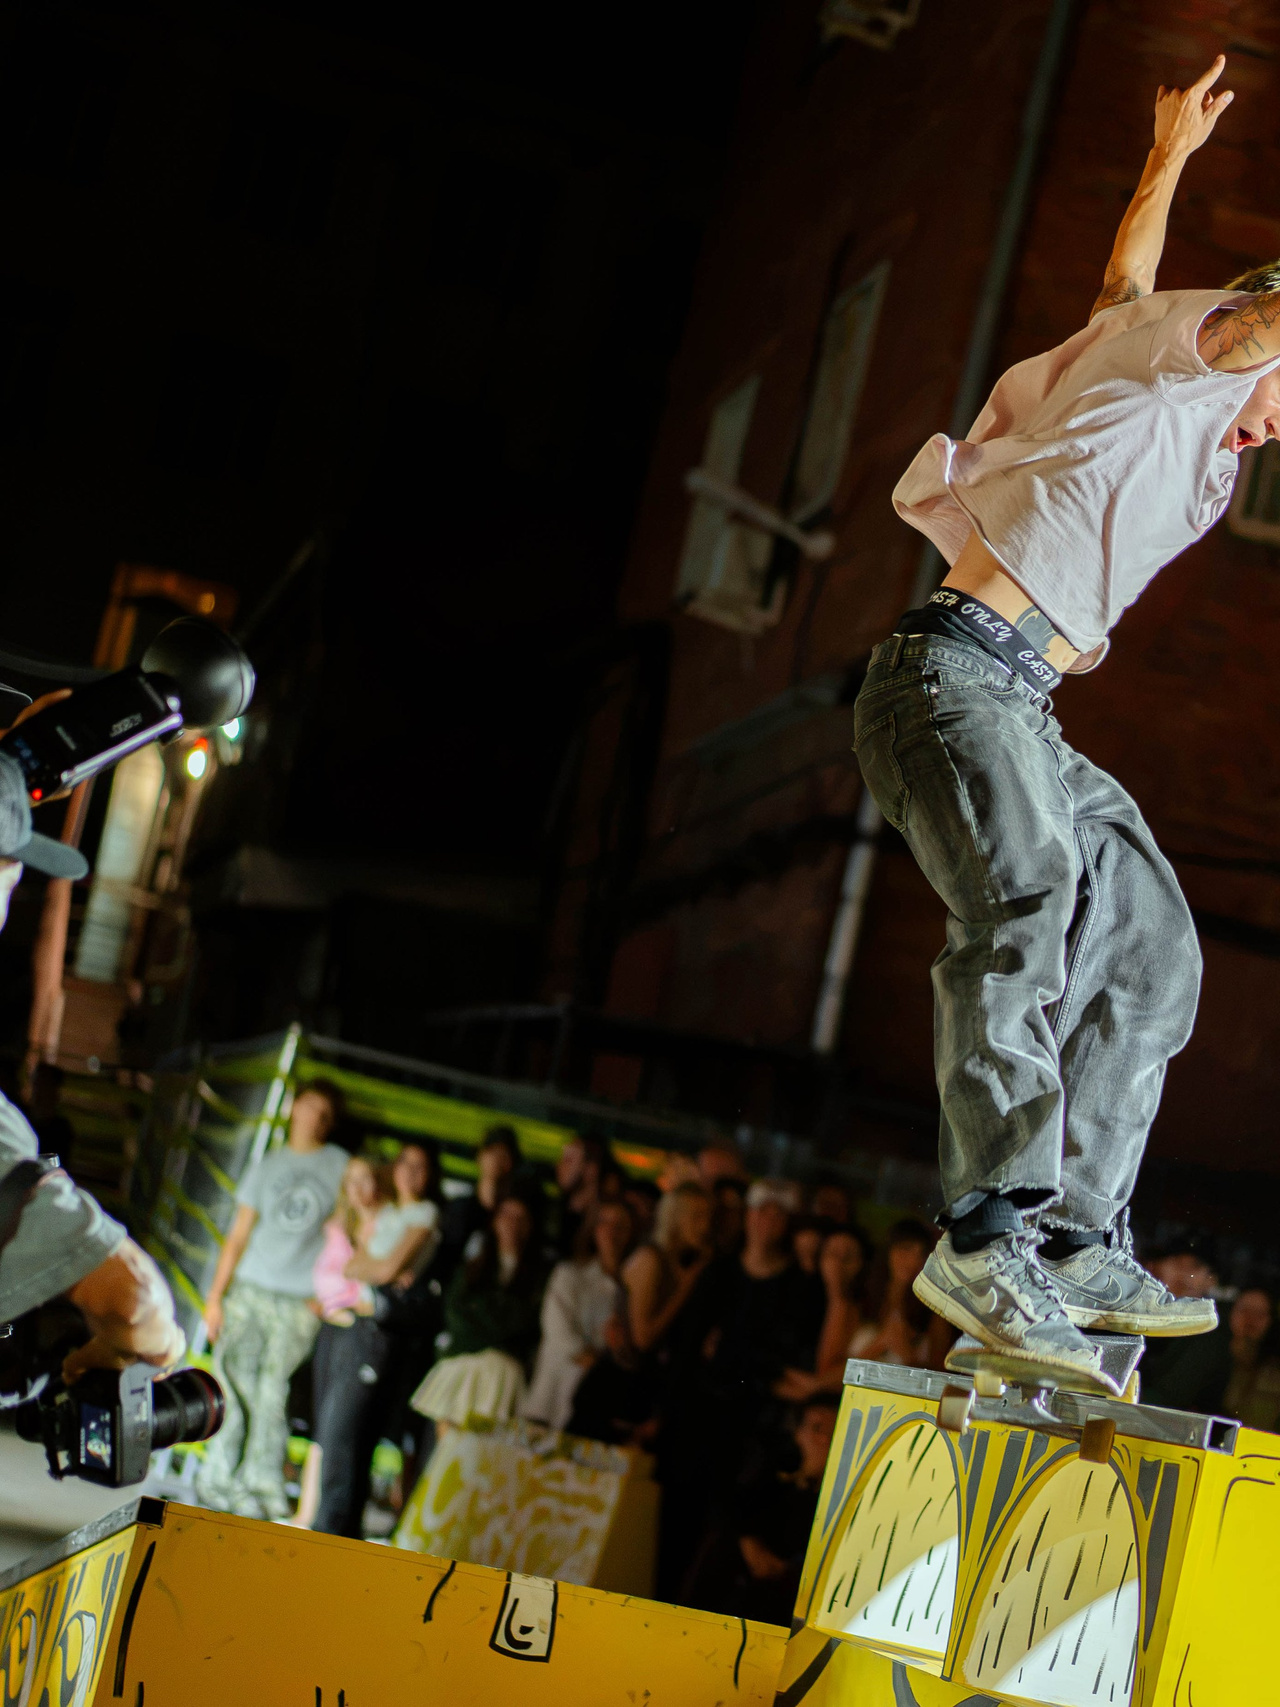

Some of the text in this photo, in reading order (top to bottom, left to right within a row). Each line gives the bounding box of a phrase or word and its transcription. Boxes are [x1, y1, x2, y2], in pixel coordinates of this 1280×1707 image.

[927, 590, 1055, 682] ASH ONLY CASH
